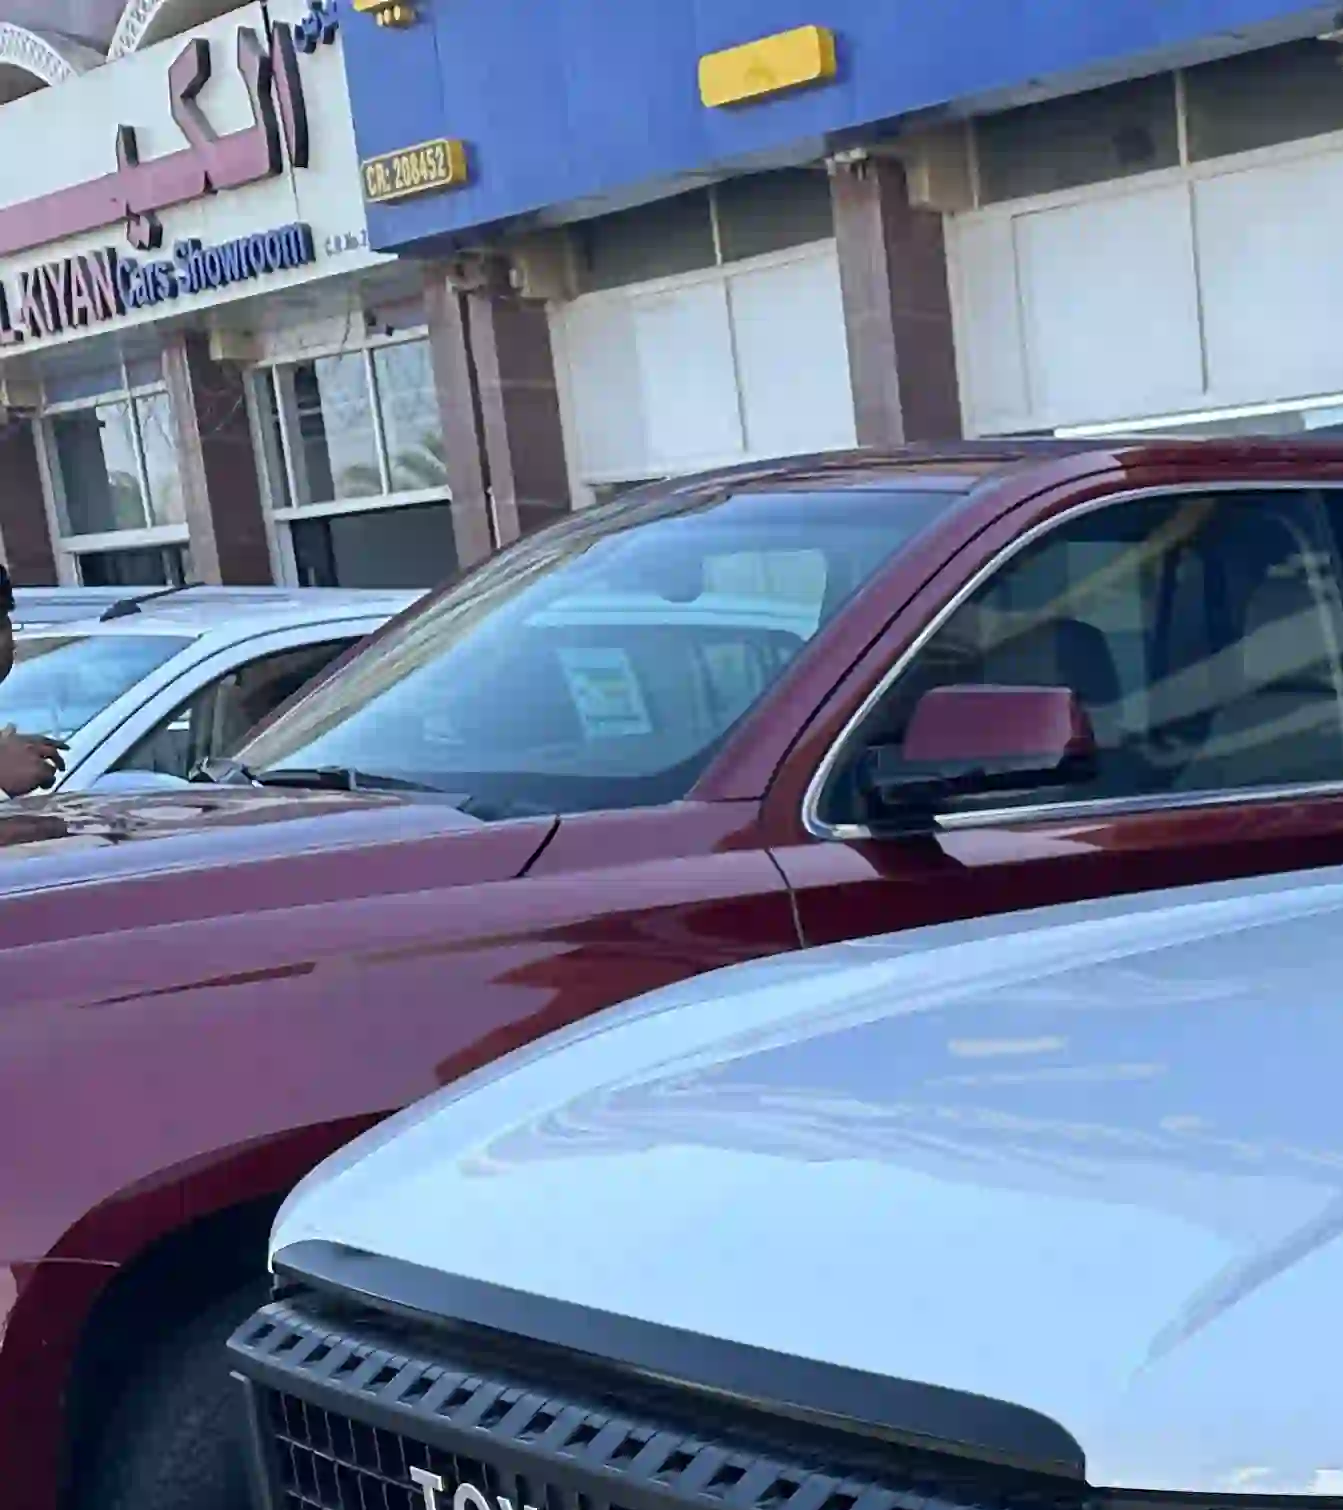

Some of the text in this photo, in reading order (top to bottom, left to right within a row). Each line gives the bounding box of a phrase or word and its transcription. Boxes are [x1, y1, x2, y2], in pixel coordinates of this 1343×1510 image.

[365, 145, 447, 196] CR: 208452
[115, 256, 174, 310] Cars
[173, 222, 315, 295] Showroom
